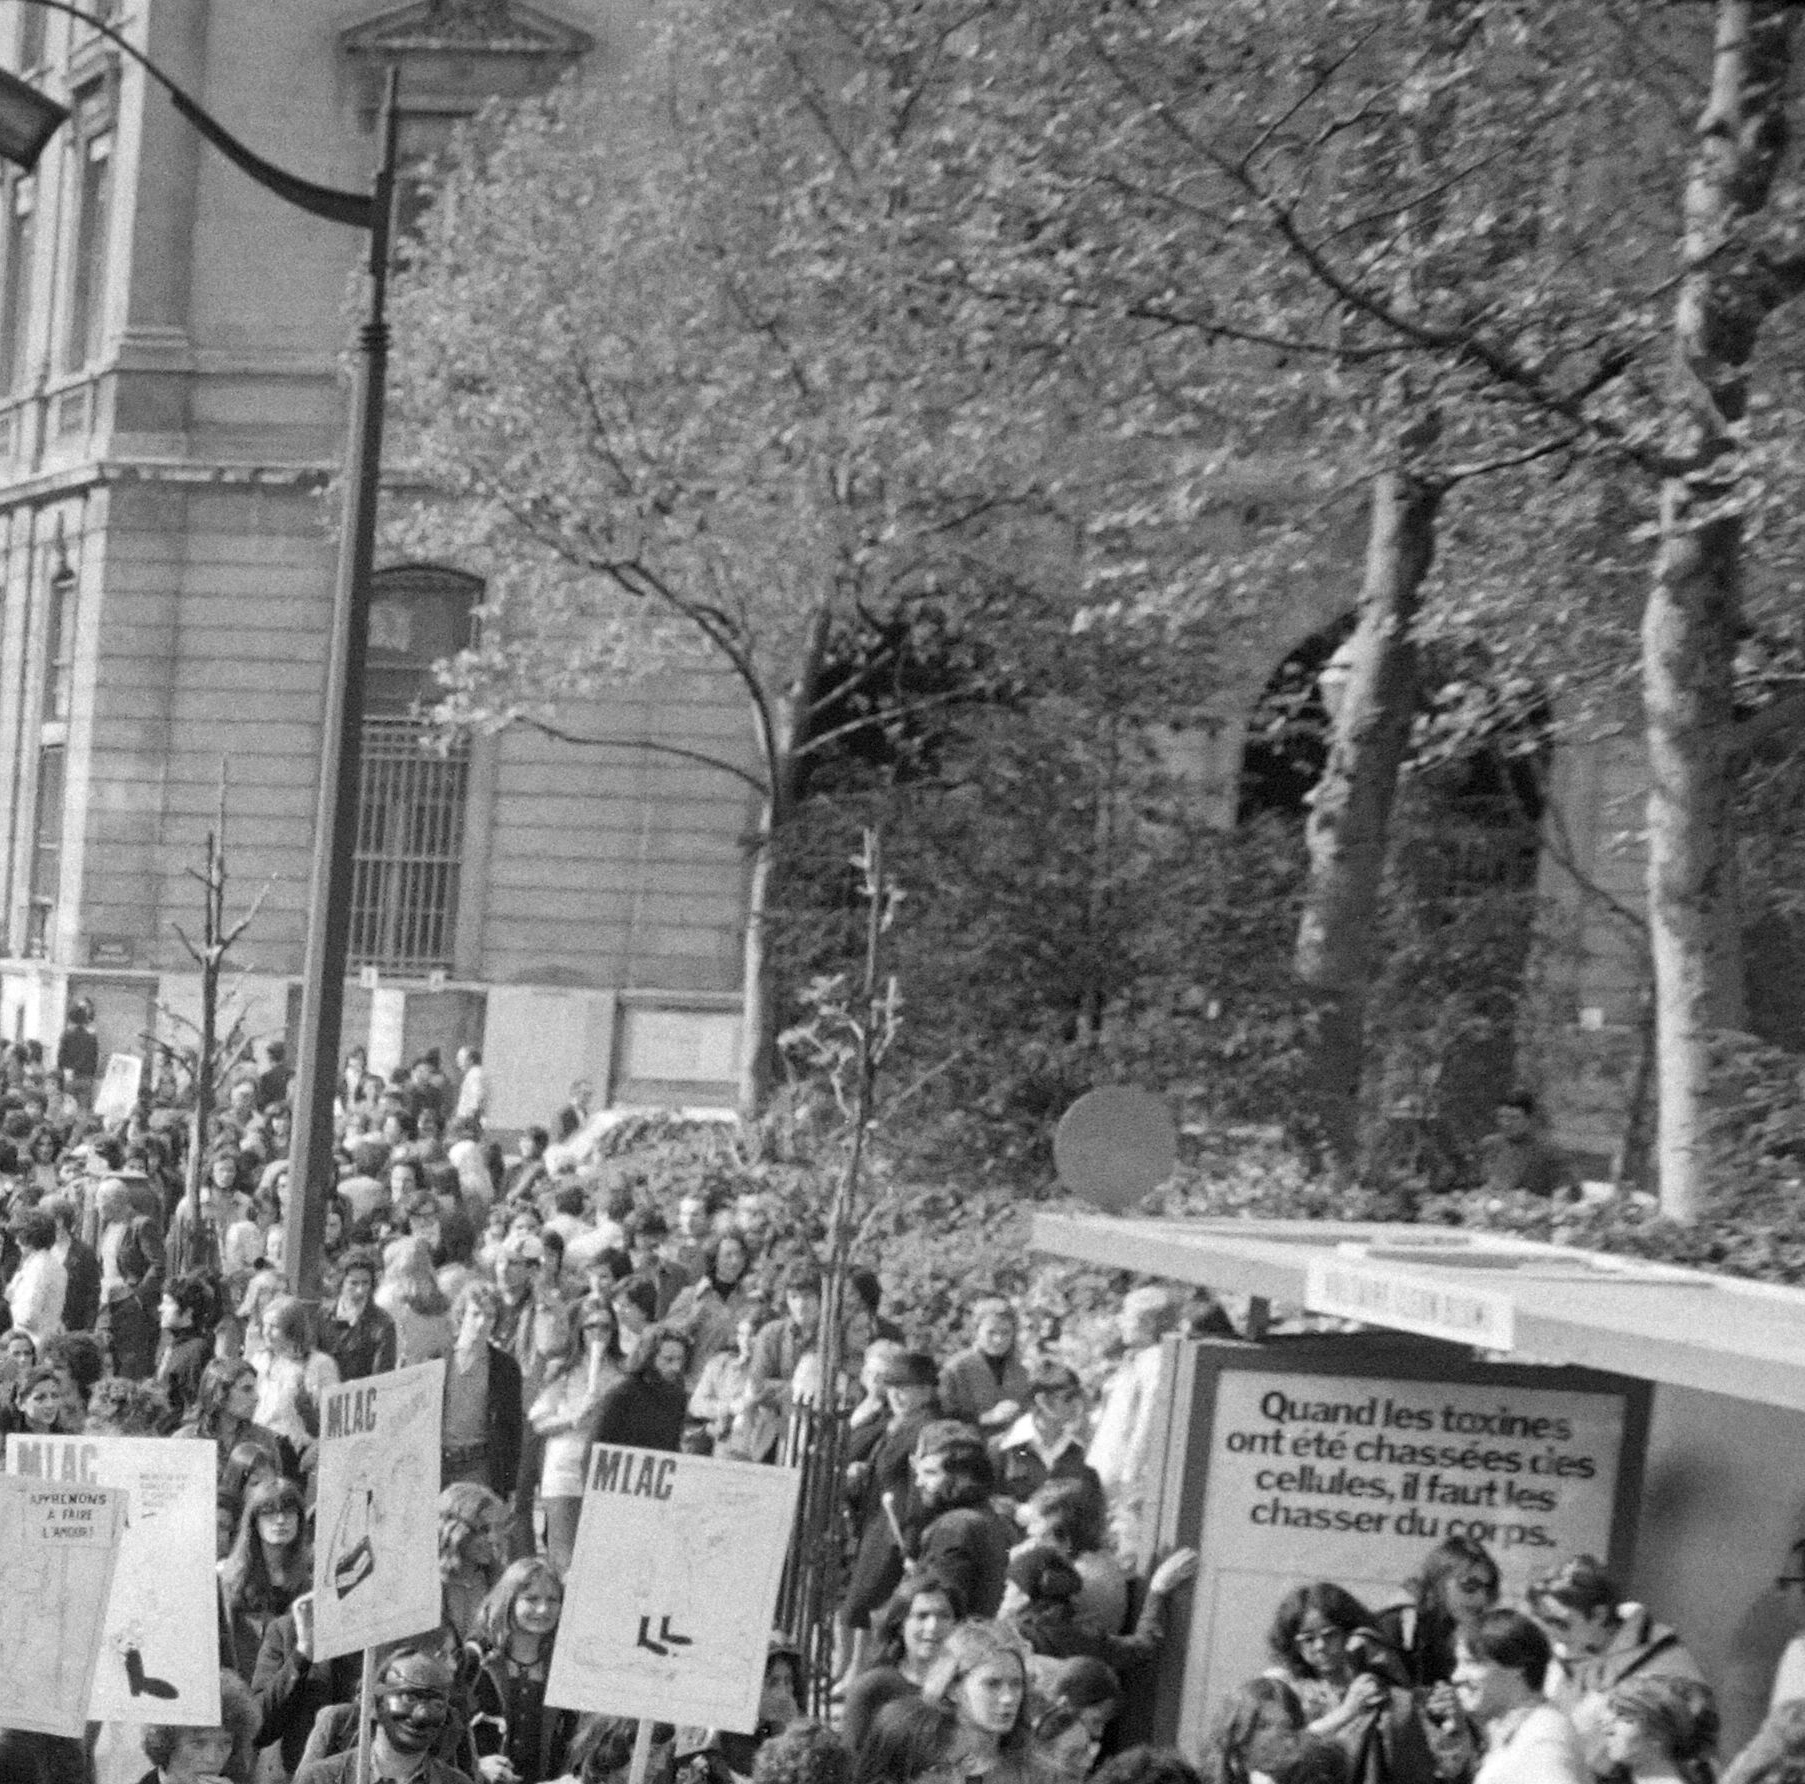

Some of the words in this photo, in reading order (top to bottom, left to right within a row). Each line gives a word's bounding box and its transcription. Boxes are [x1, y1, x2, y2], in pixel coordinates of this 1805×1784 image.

[326, 1387, 378, 1441] MLAC
[1260, 1390, 1378, 1426] Quand
[1381, 1397, 1434, 1432] les
[1441, 1404, 1572, 1442] toxines
[16, 1441, 99, 1488] MLAC
[593, 1448, 677, 1499] MLAC
[1225, 1428, 1285, 1456] ont
[1291, 1427, 1348, 1461] été
[1353, 1433, 1522, 1474] chassées
[1529, 1446, 1596, 1479] des
[30, 1492, 108, 1506] APPRENONS
[1255, 1464, 1396, 1505] cellules,
[1401, 1470, 1421, 1501] il
[1427, 1472, 1499, 1508] faut
[1506, 1479, 1558, 1513] les
[62, 1508, 94, 1521] FAIRE
[1249, 1496, 1389, 1535] chasser
[1394, 1507, 1440, 1538] du
[1445, 1519, 1558, 1551] corps.
